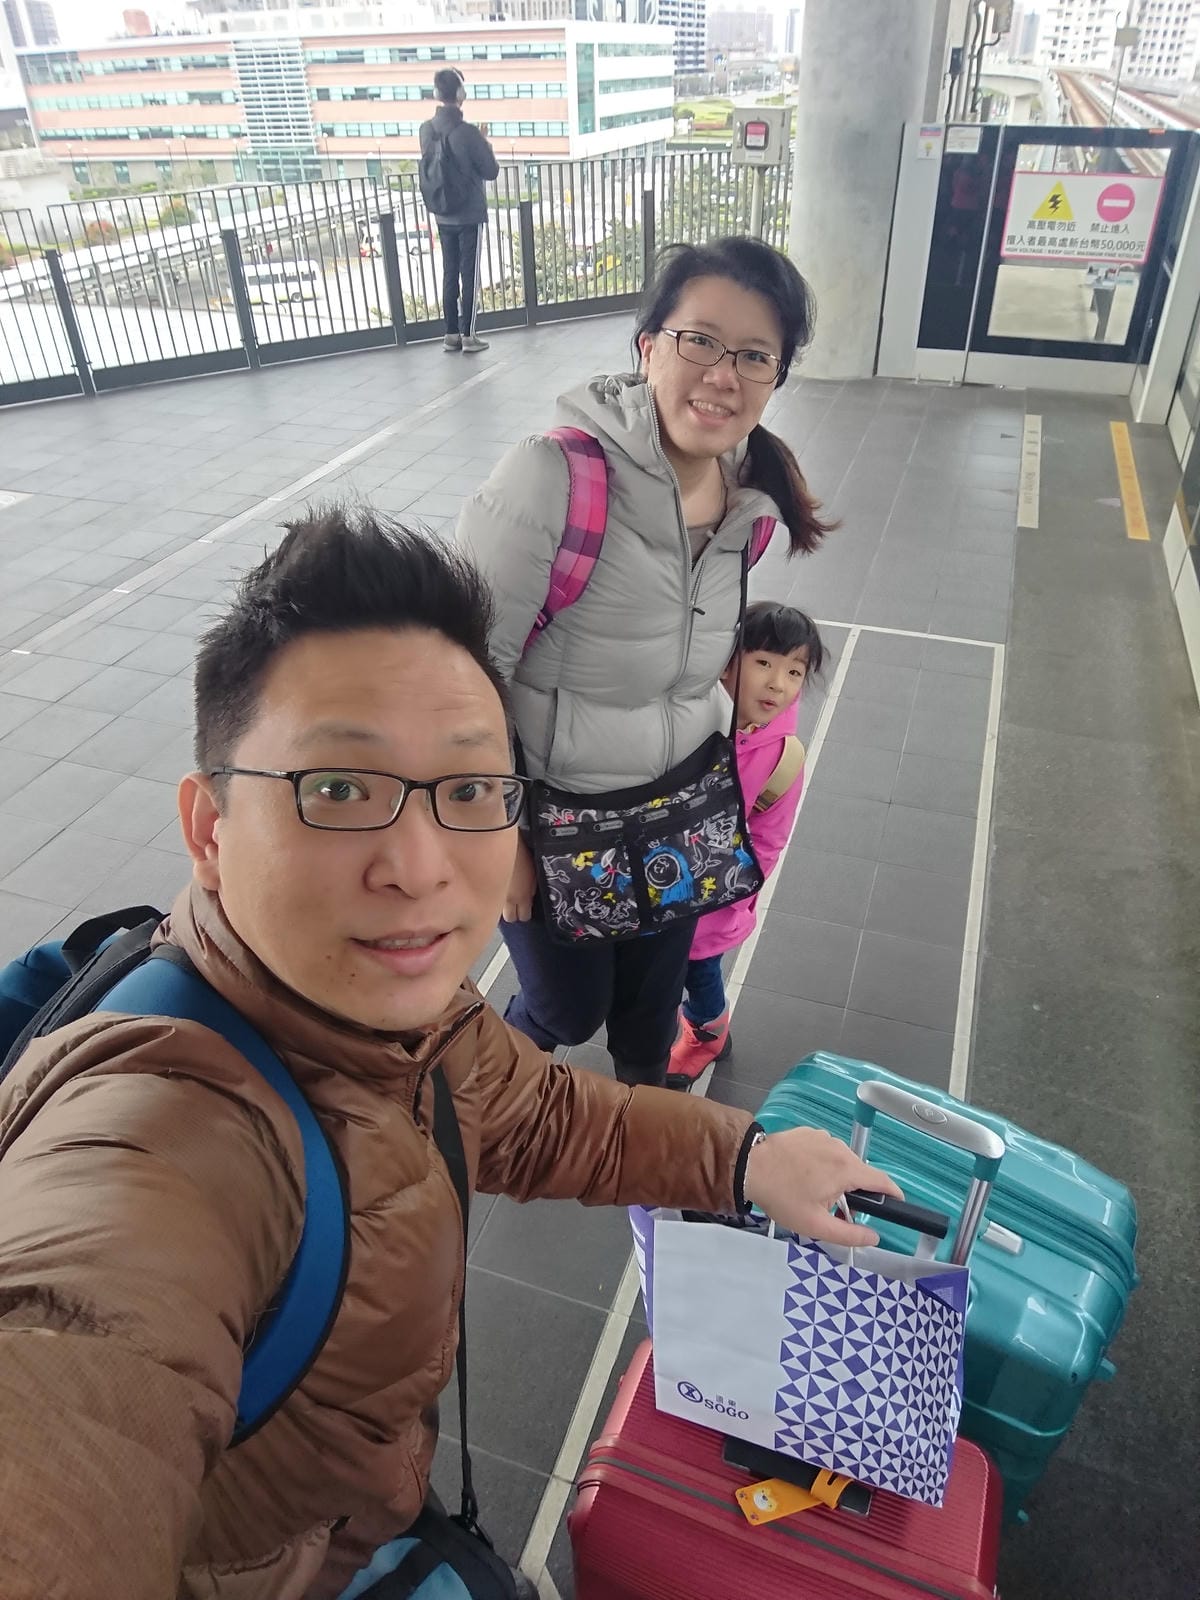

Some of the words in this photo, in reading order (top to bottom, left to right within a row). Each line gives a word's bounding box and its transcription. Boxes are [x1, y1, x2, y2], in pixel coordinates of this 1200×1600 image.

[1089, 223, 1130, 234] 禁止進入
[704, 1399, 749, 1420] SOGO
